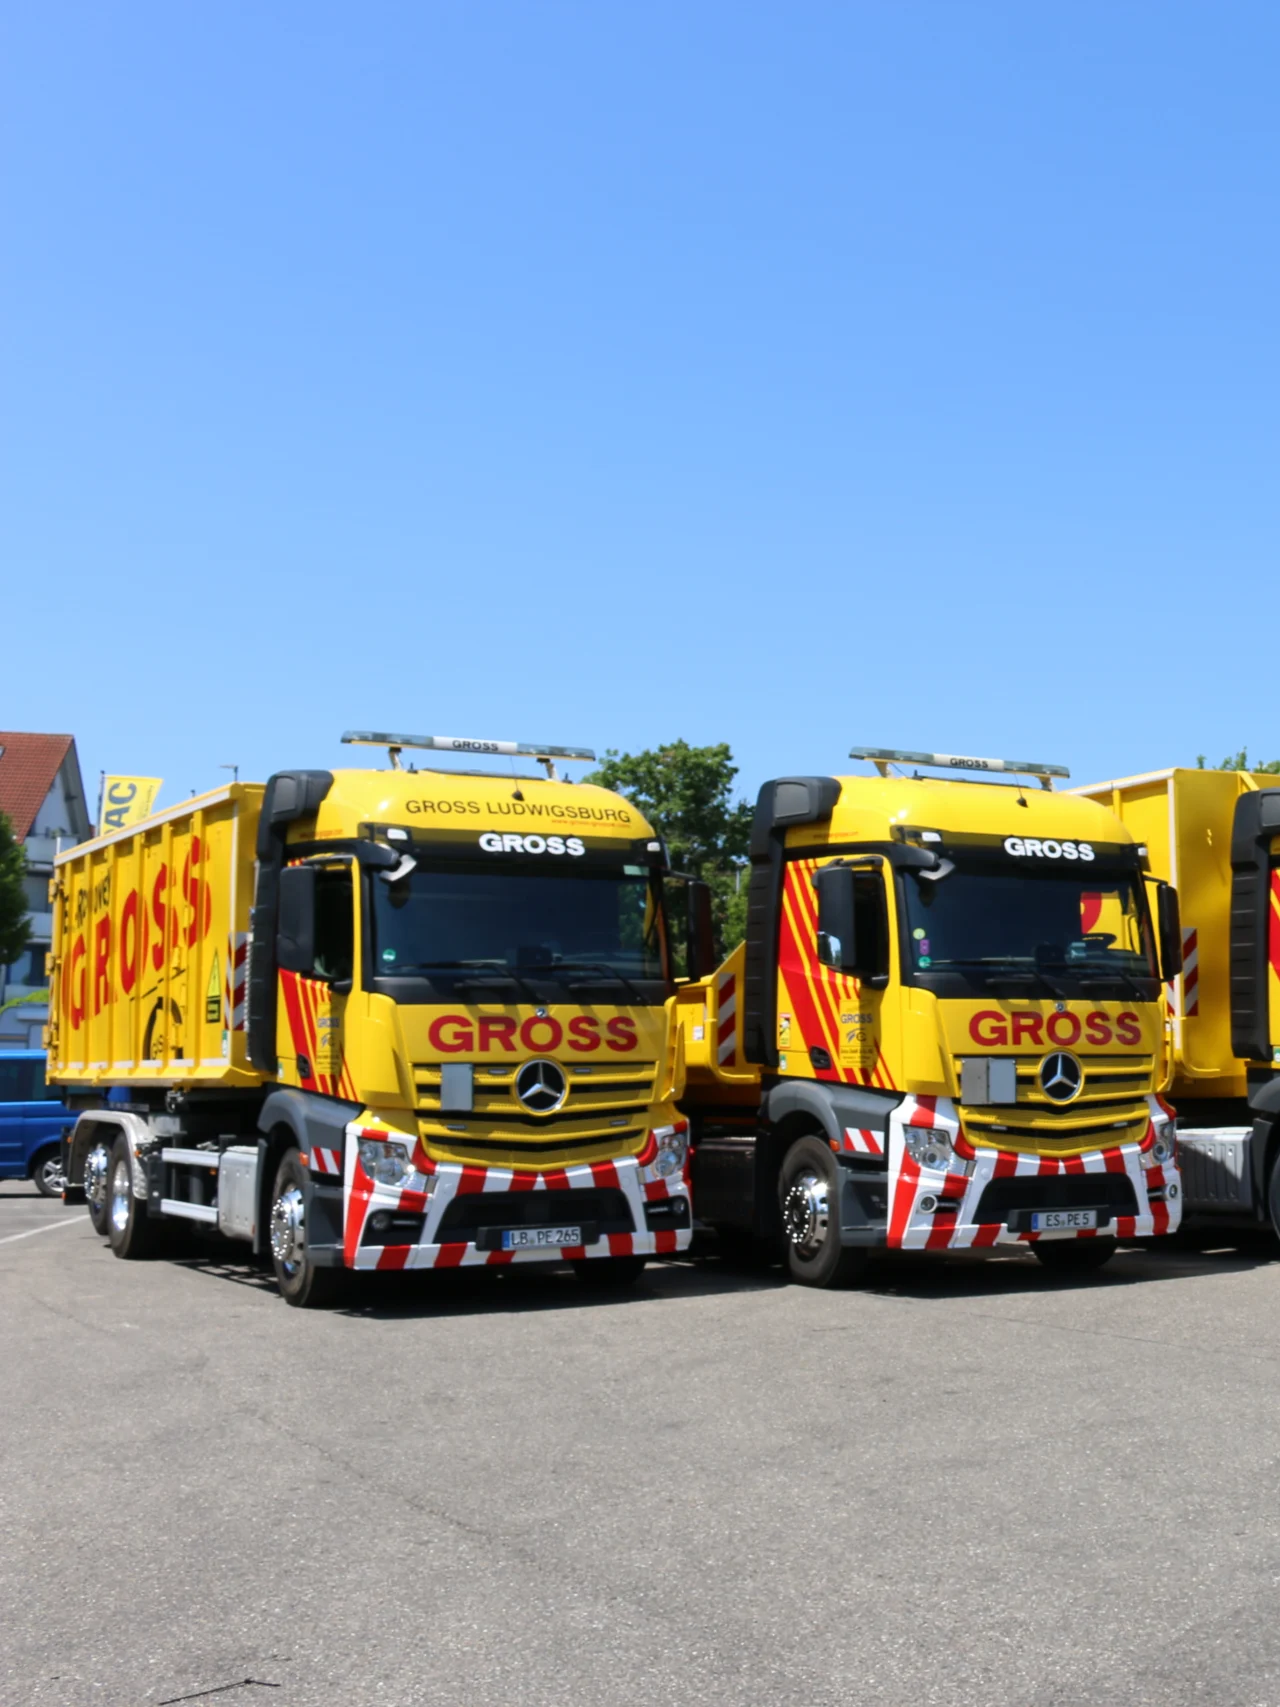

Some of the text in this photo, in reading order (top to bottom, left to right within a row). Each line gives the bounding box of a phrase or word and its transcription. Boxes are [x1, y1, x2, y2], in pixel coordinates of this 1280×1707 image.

[452, 739, 499, 751] GROSS
[949, 757, 988, 769] GROSS
[405, 800, 631, 823] GROSS LUDWIGSBURG
[479, 834, 585, 856] GROSS
[1004, 837, 1095, 861] GROSS
[60, 835, 212, 1031] GROSS
[841, 1013, 873, 1024] GROSS
[969, 1010, 1141, 1046] GROSS
[428, 1015, 638, 1052] GROSS
[1046, 1213, 1089, 1227] ES PE 5
[511, 1228, 579, 1246] LB PE 265
